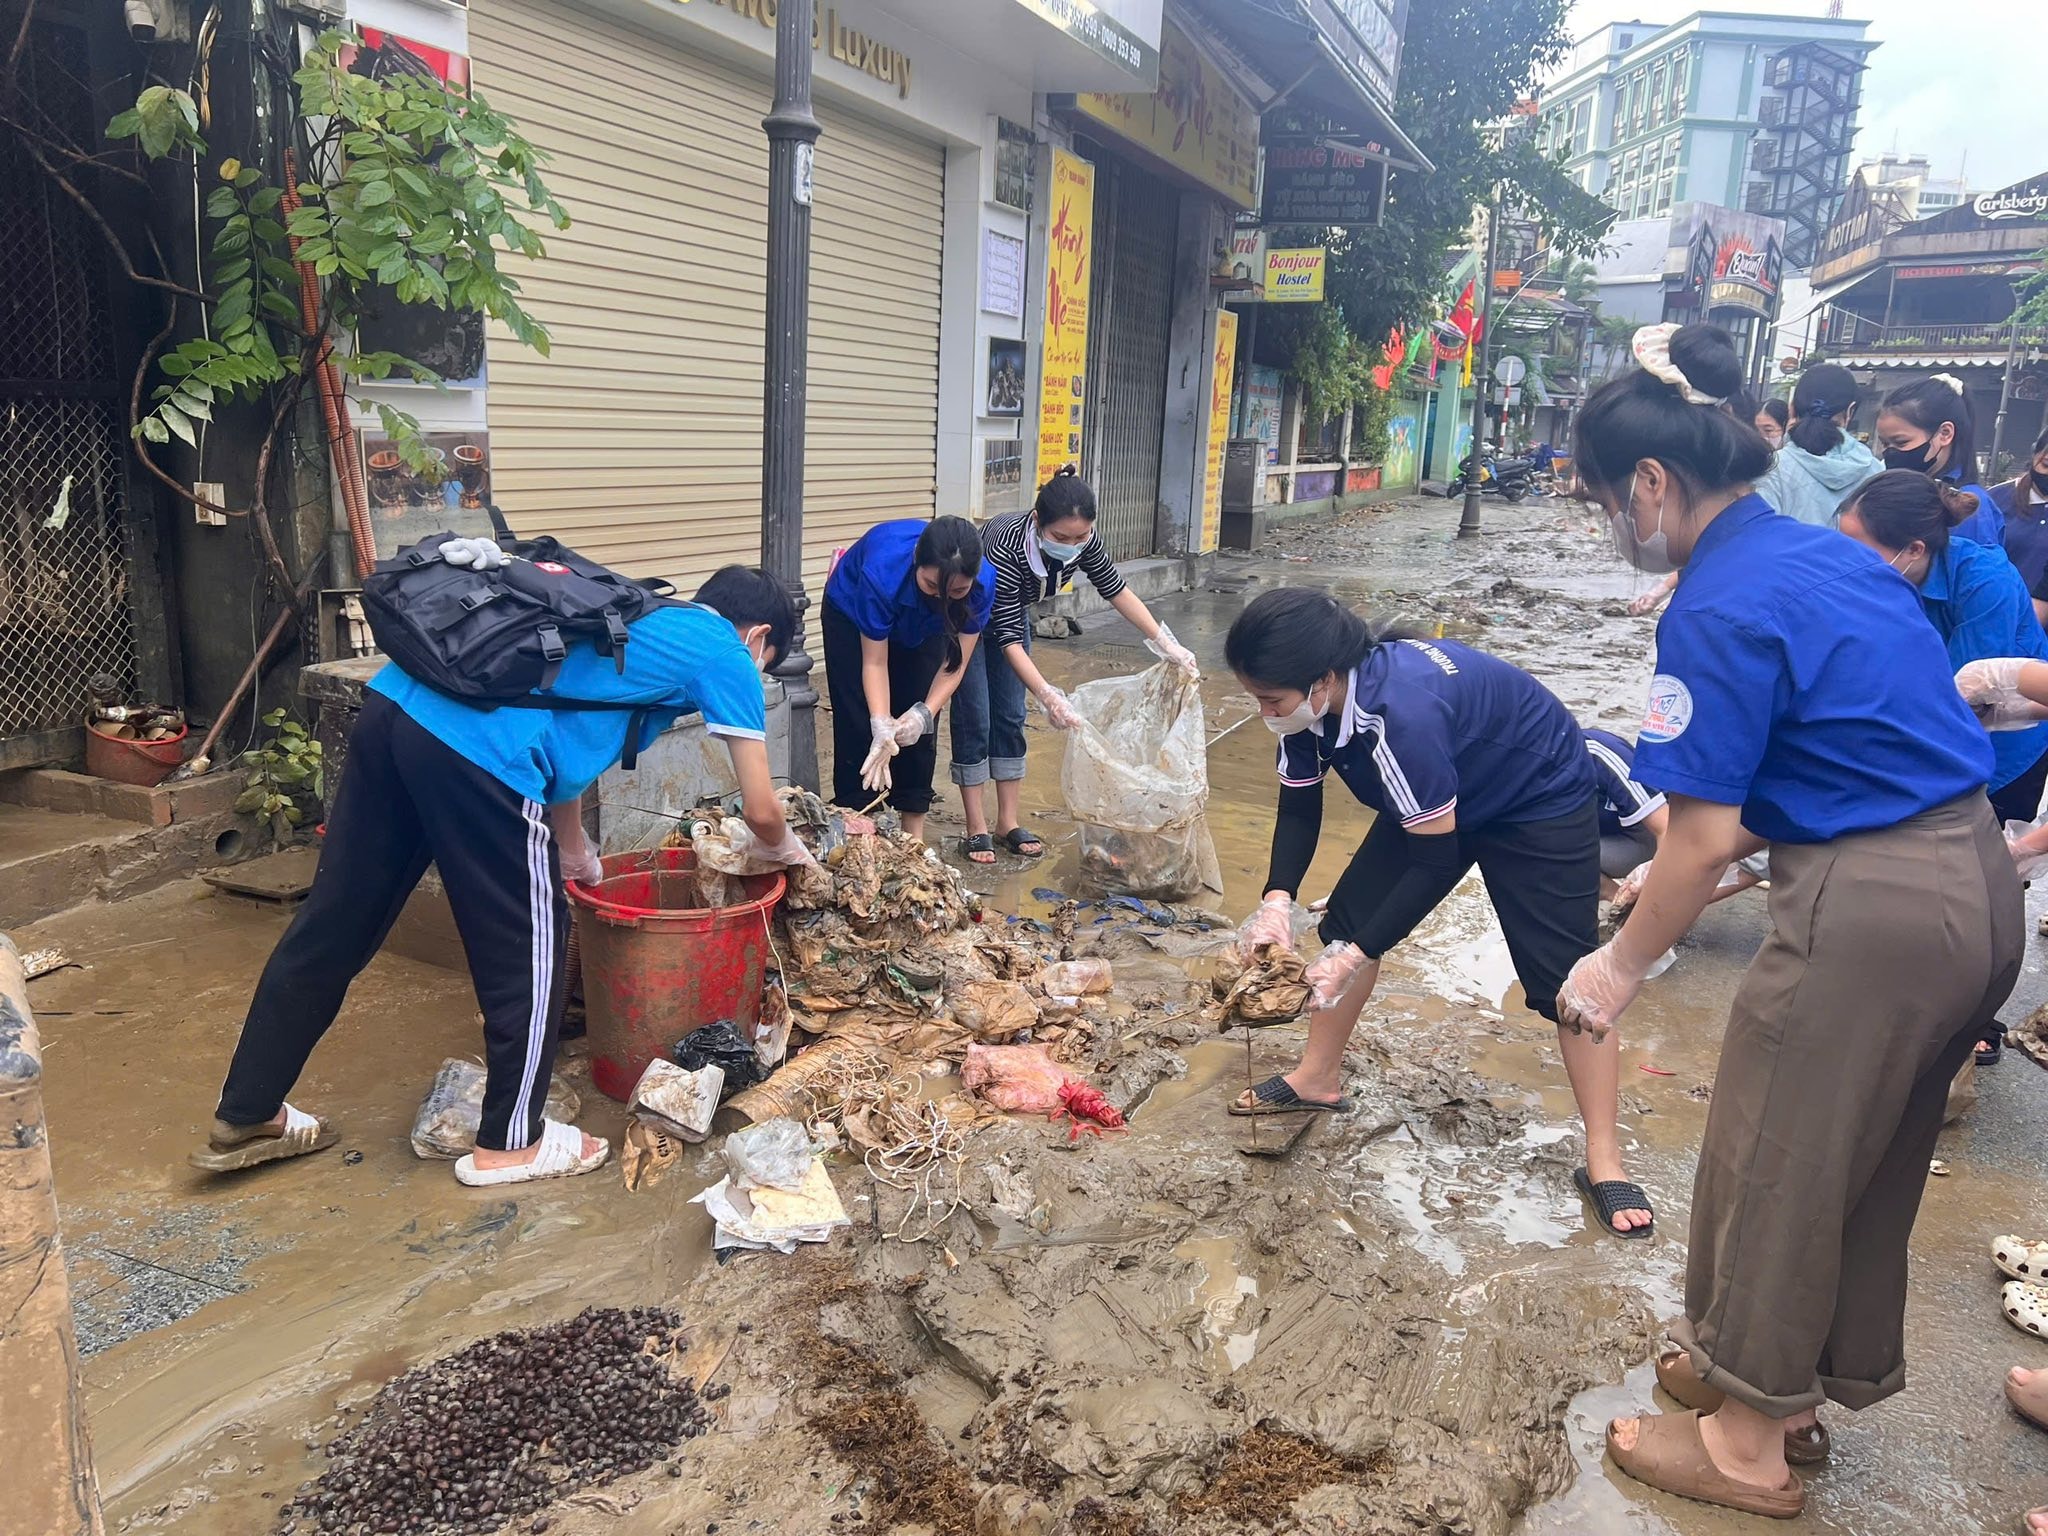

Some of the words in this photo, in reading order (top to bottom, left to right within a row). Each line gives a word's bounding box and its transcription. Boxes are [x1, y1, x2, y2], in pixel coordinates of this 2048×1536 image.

[828, 8, 912, 99] Luxury
[1117, 36, 1129, 60] 353
[1129, 46, 1141, 68] 599
[1974, 192, 2048, 217] Carlsberg
[1269, 253, 1321, 272] Bonjour
[1277, 273, 1312, 285] Hostel
